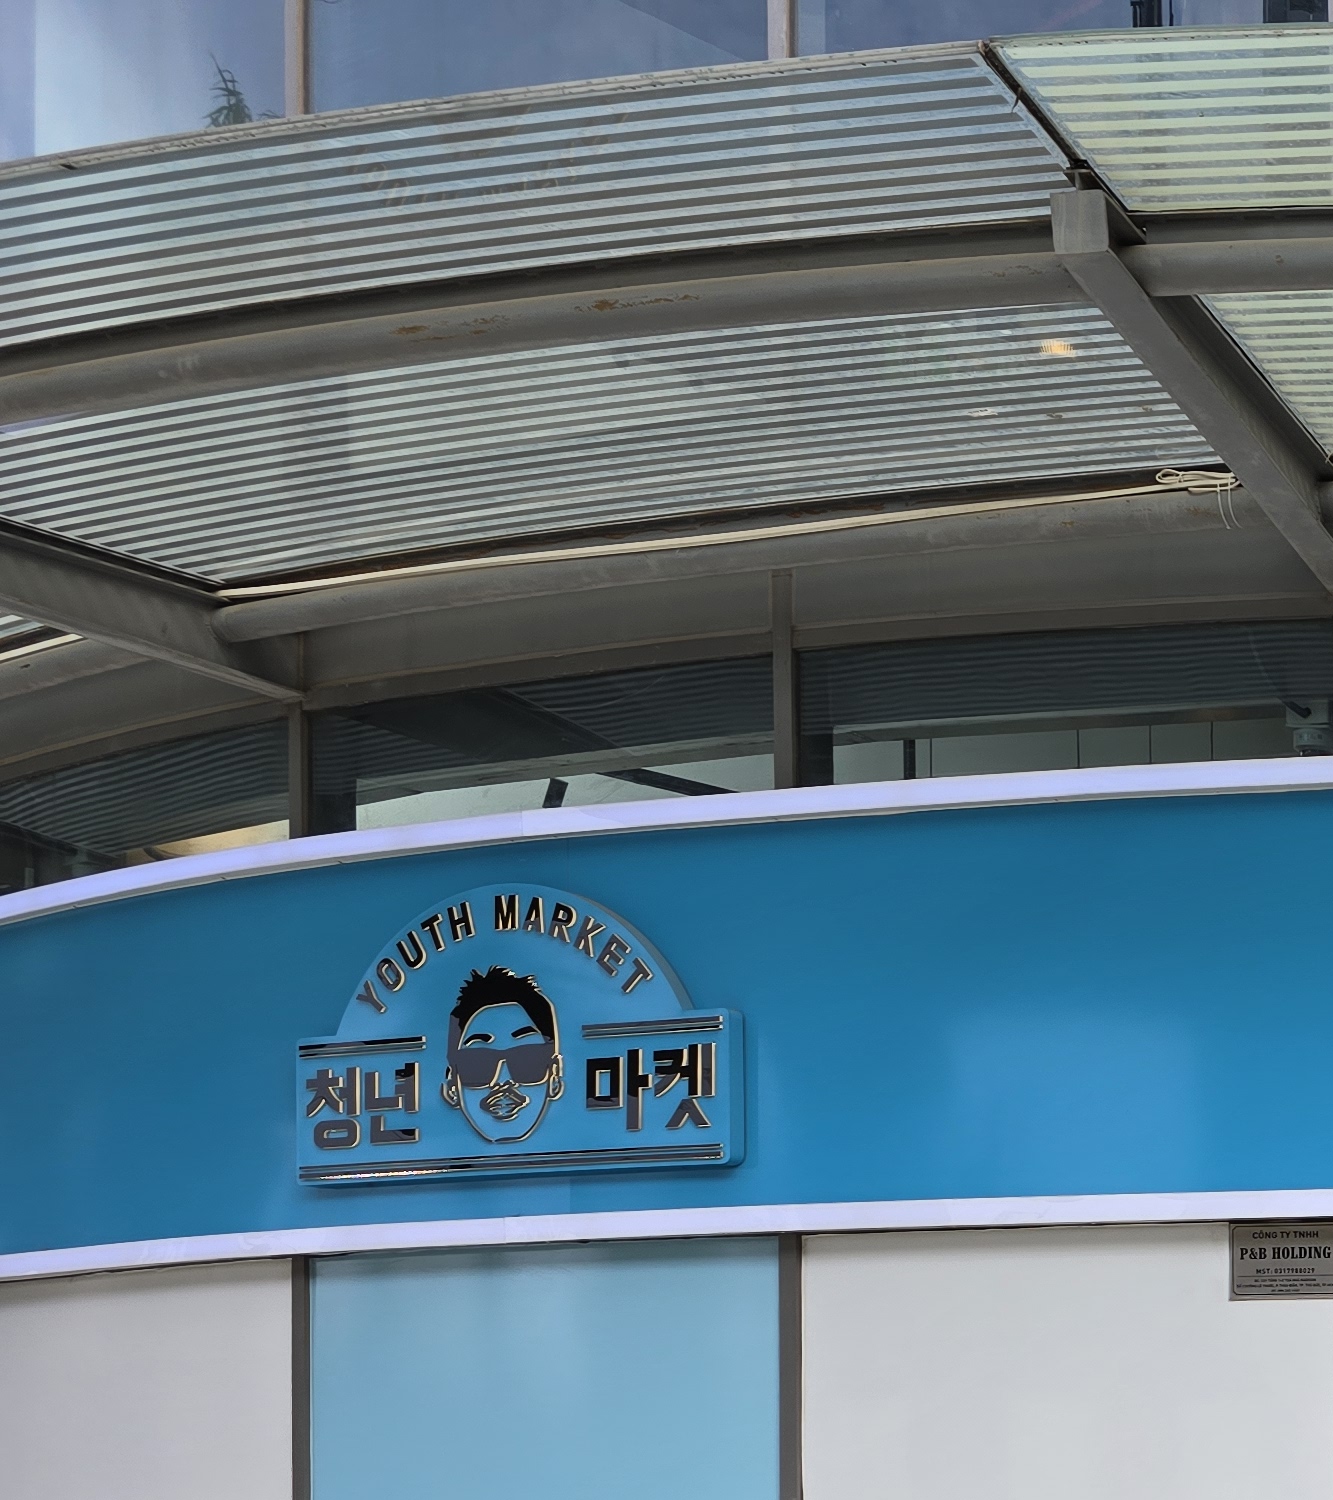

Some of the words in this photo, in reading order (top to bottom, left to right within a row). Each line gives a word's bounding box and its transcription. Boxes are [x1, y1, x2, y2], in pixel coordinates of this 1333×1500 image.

[356, 900, 475, 1013] YOUTH
[493, 893, 655, 995] MARKET
[305, 1061, 420, 1150] 청년
[585, 1042, 716, 1131] 마켓
[1240, 1247, 1267, 1260] P&B
[1272, 1246, 1332, 1260] HOLDING
[1252, 1230, 1278, 1239] CÔNG
[1280, 1231, 1291, 1239] TY
[1293, 1231, 1319, 1239] TNHH
